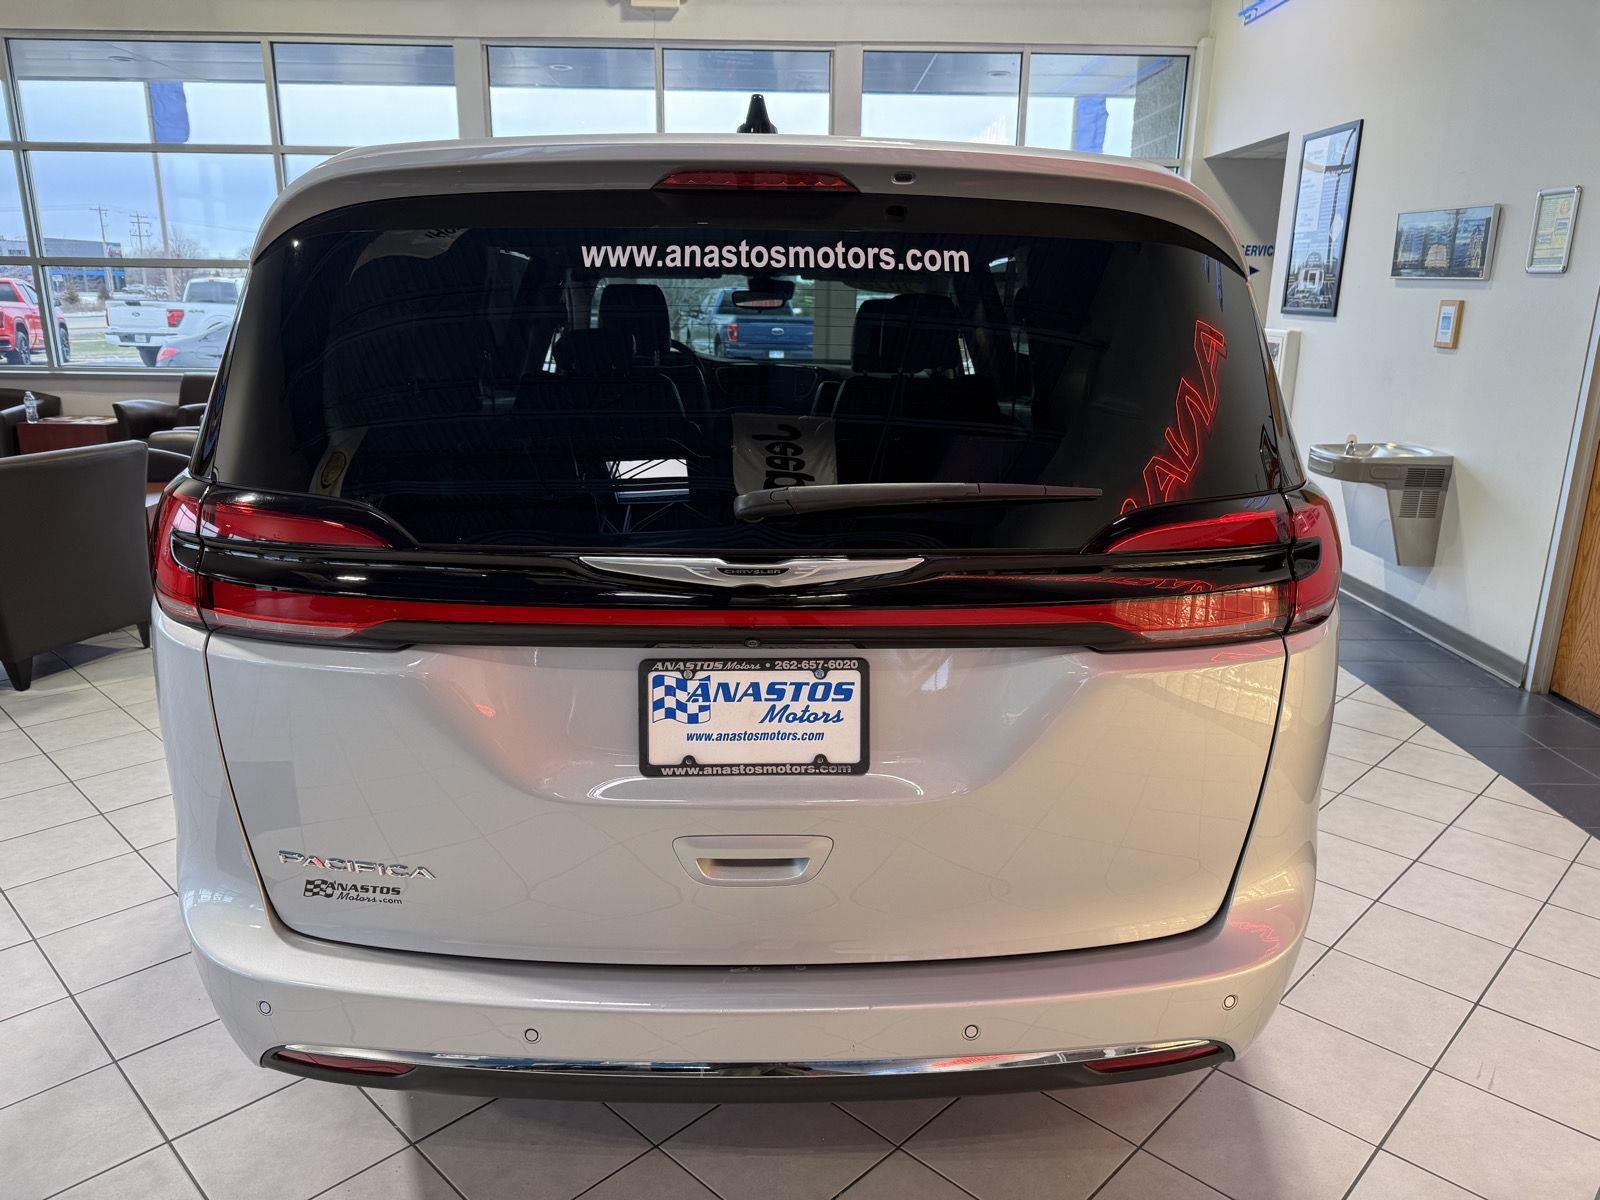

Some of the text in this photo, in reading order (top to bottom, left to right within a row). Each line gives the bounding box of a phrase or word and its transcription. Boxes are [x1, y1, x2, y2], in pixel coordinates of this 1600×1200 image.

[581, 240, 970, 273] www.anastosmotors.com
[1241, 244, 1275, 257] ERVIC
[651, 660, 859, 671] ANASTOS Motors 262-657-6020
[685, 680, 856, 703] ANASTOS
[758, 703, 844, 724] Motors
[686, 730, 825, 743] www.anastosmotors.com
[660, 764, 852, 776] www.anastosmotors.com
[278, 850, 437, 880] PACIFICA
[323, 880, 402, 896] ANASTOS
